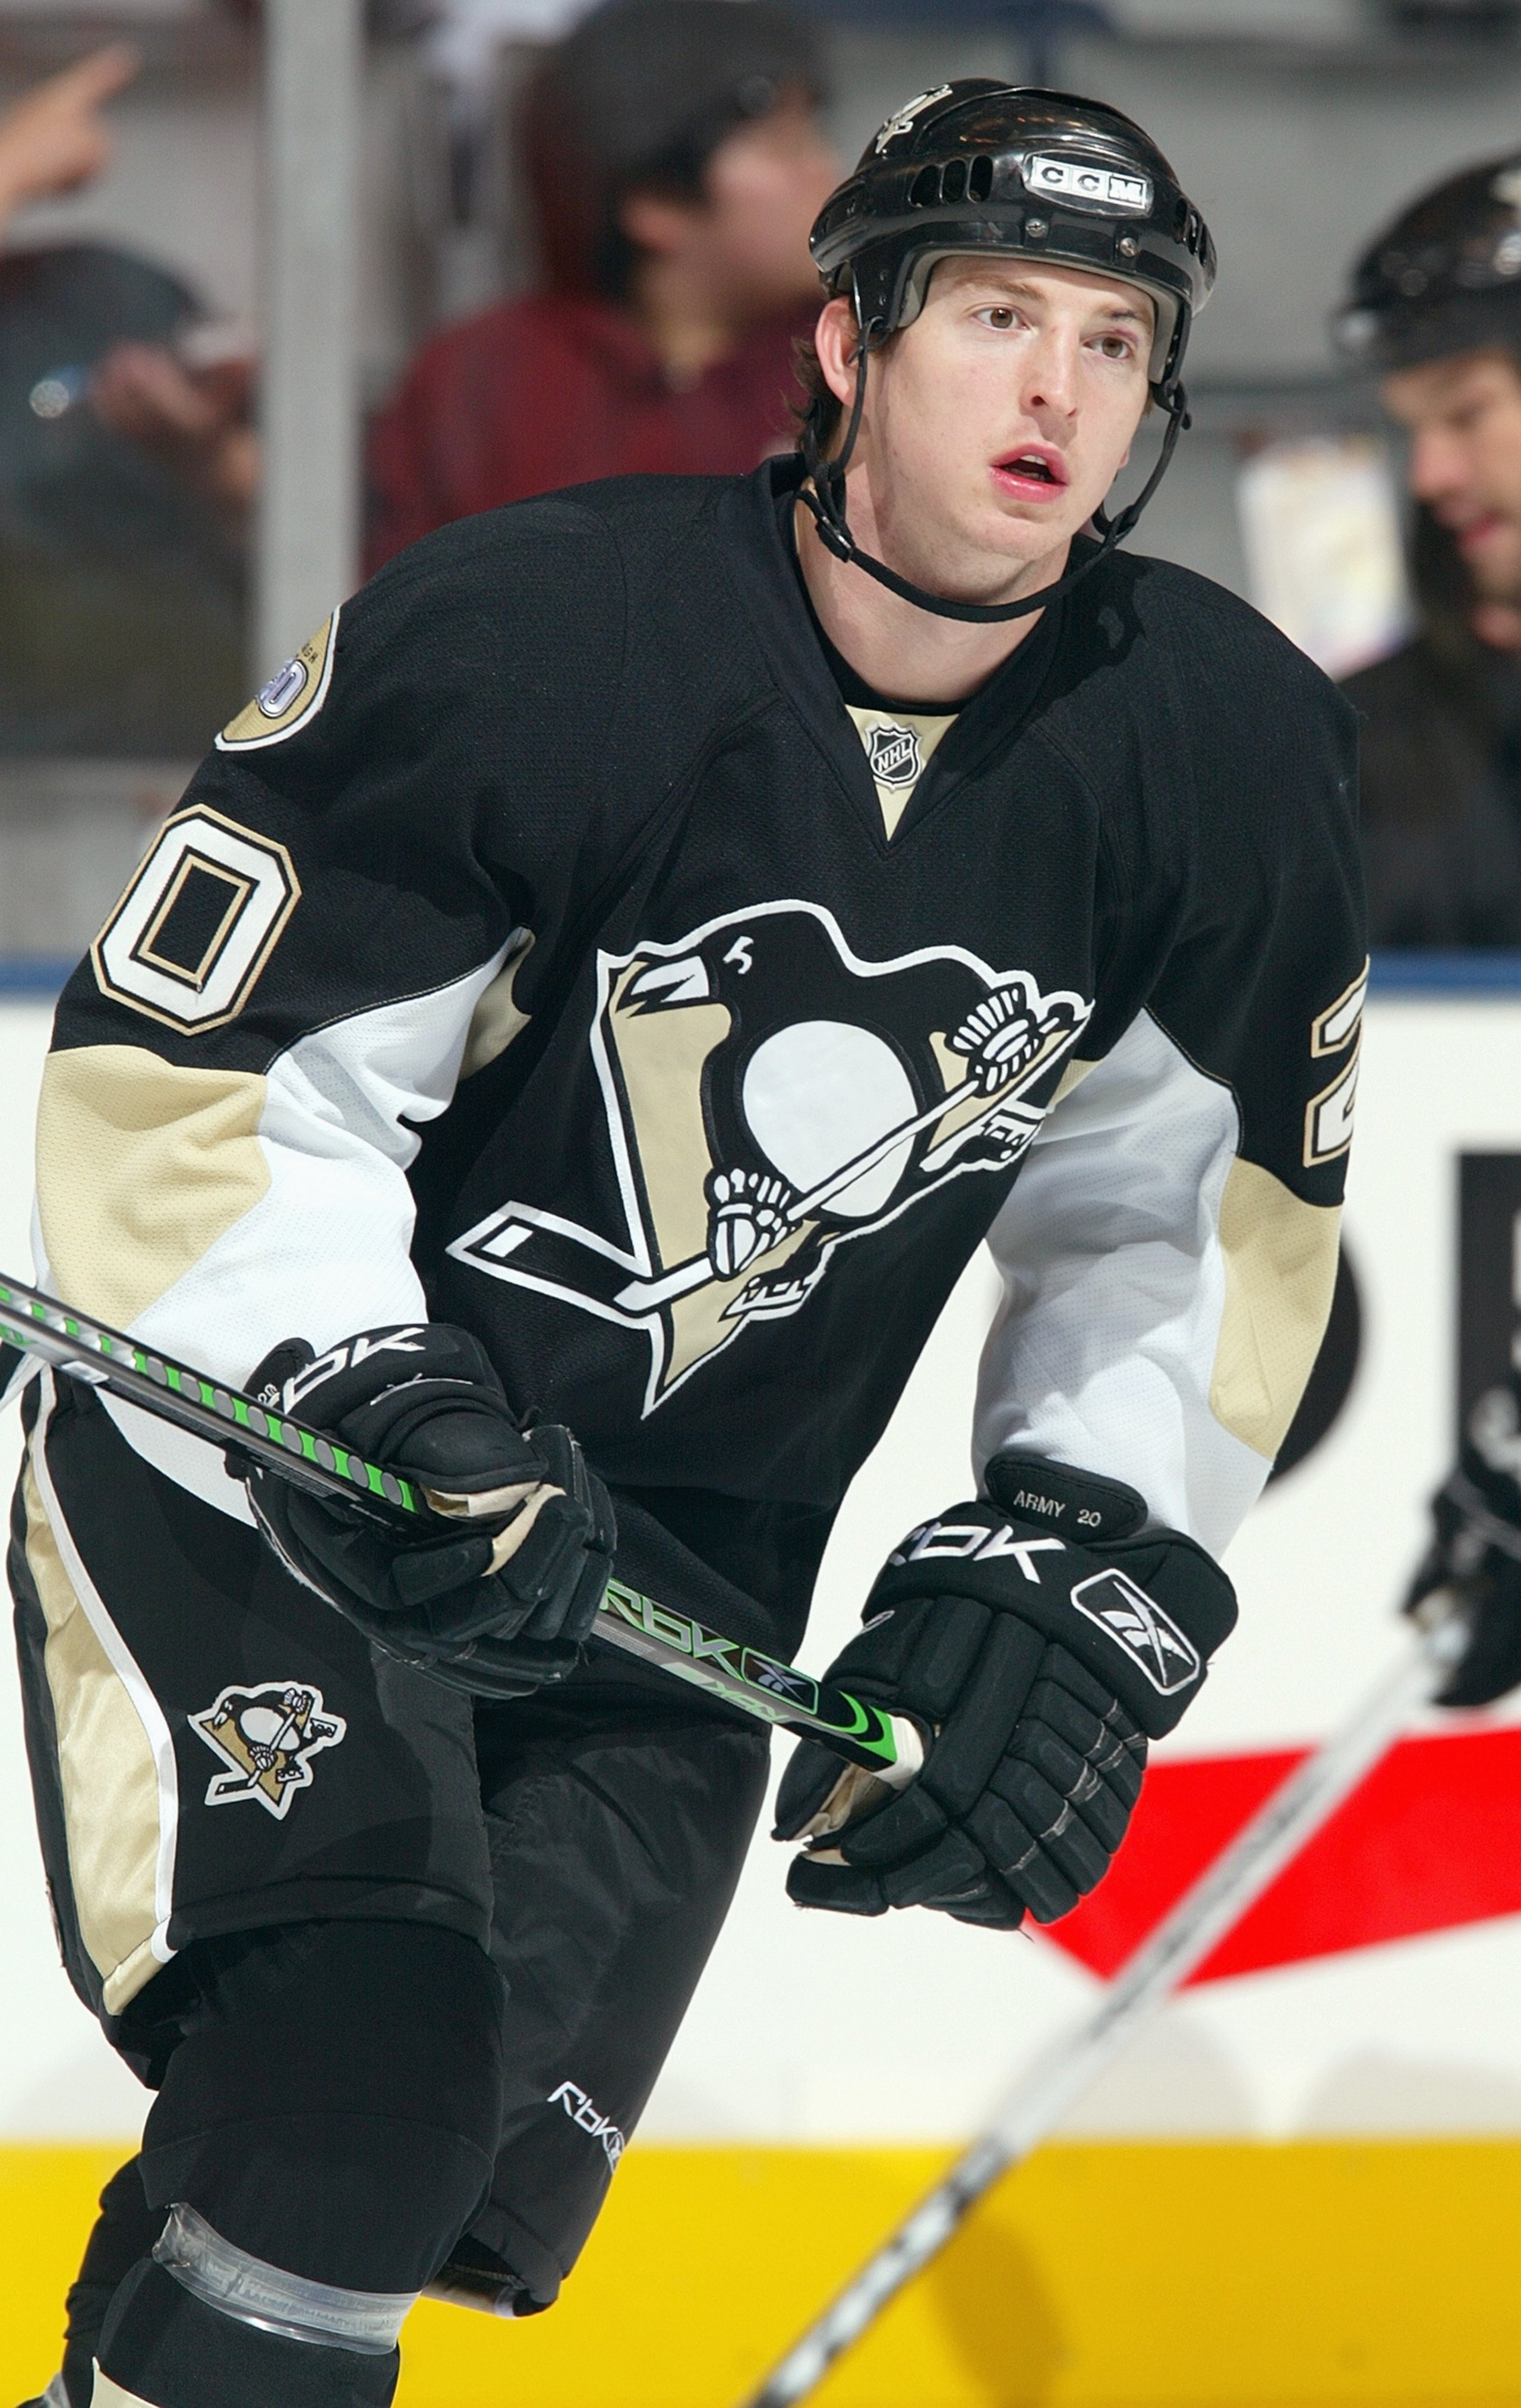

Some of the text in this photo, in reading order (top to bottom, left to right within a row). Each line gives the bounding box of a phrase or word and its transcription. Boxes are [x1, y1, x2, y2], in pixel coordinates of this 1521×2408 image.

[1040, 166, 1144, 206] CCM
[878, 741, 911, 773] NHL
[1012, 1489, 1102, 1527] ARMY 20
